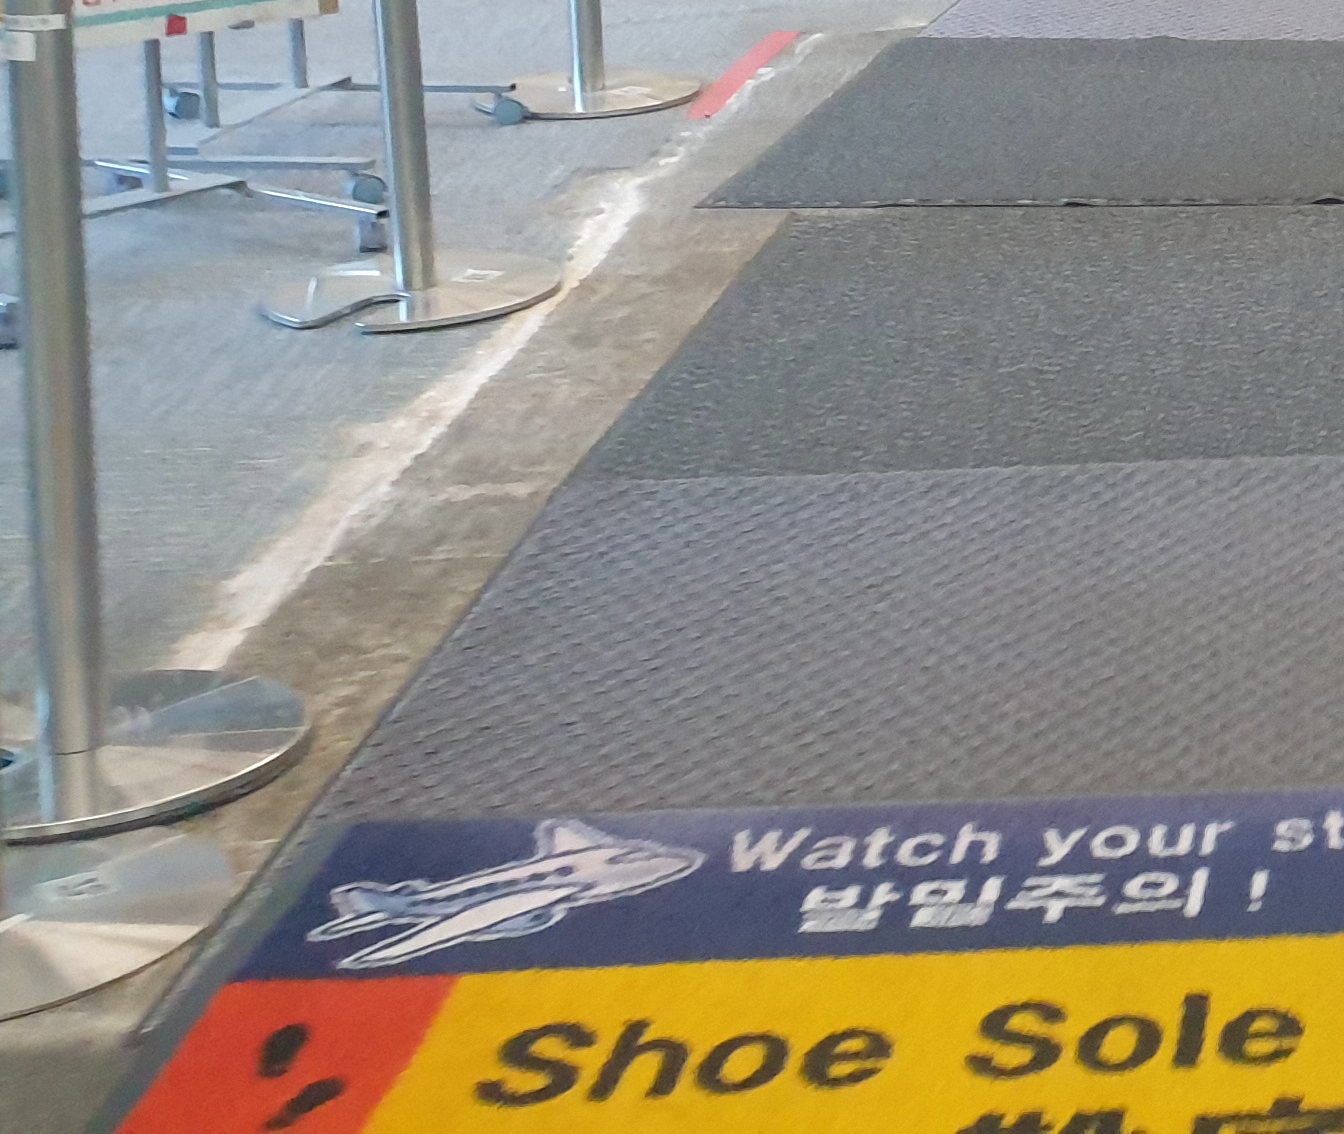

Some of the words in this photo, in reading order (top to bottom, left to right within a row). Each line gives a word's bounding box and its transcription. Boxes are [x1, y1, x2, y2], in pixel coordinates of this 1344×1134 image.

[728, 821, 1001, 873] Watch
[1035, 818, 1234, 867] your
[473, 1017, 895, 1111] Shoe
[965, 991, 1305, 1080] Sole
